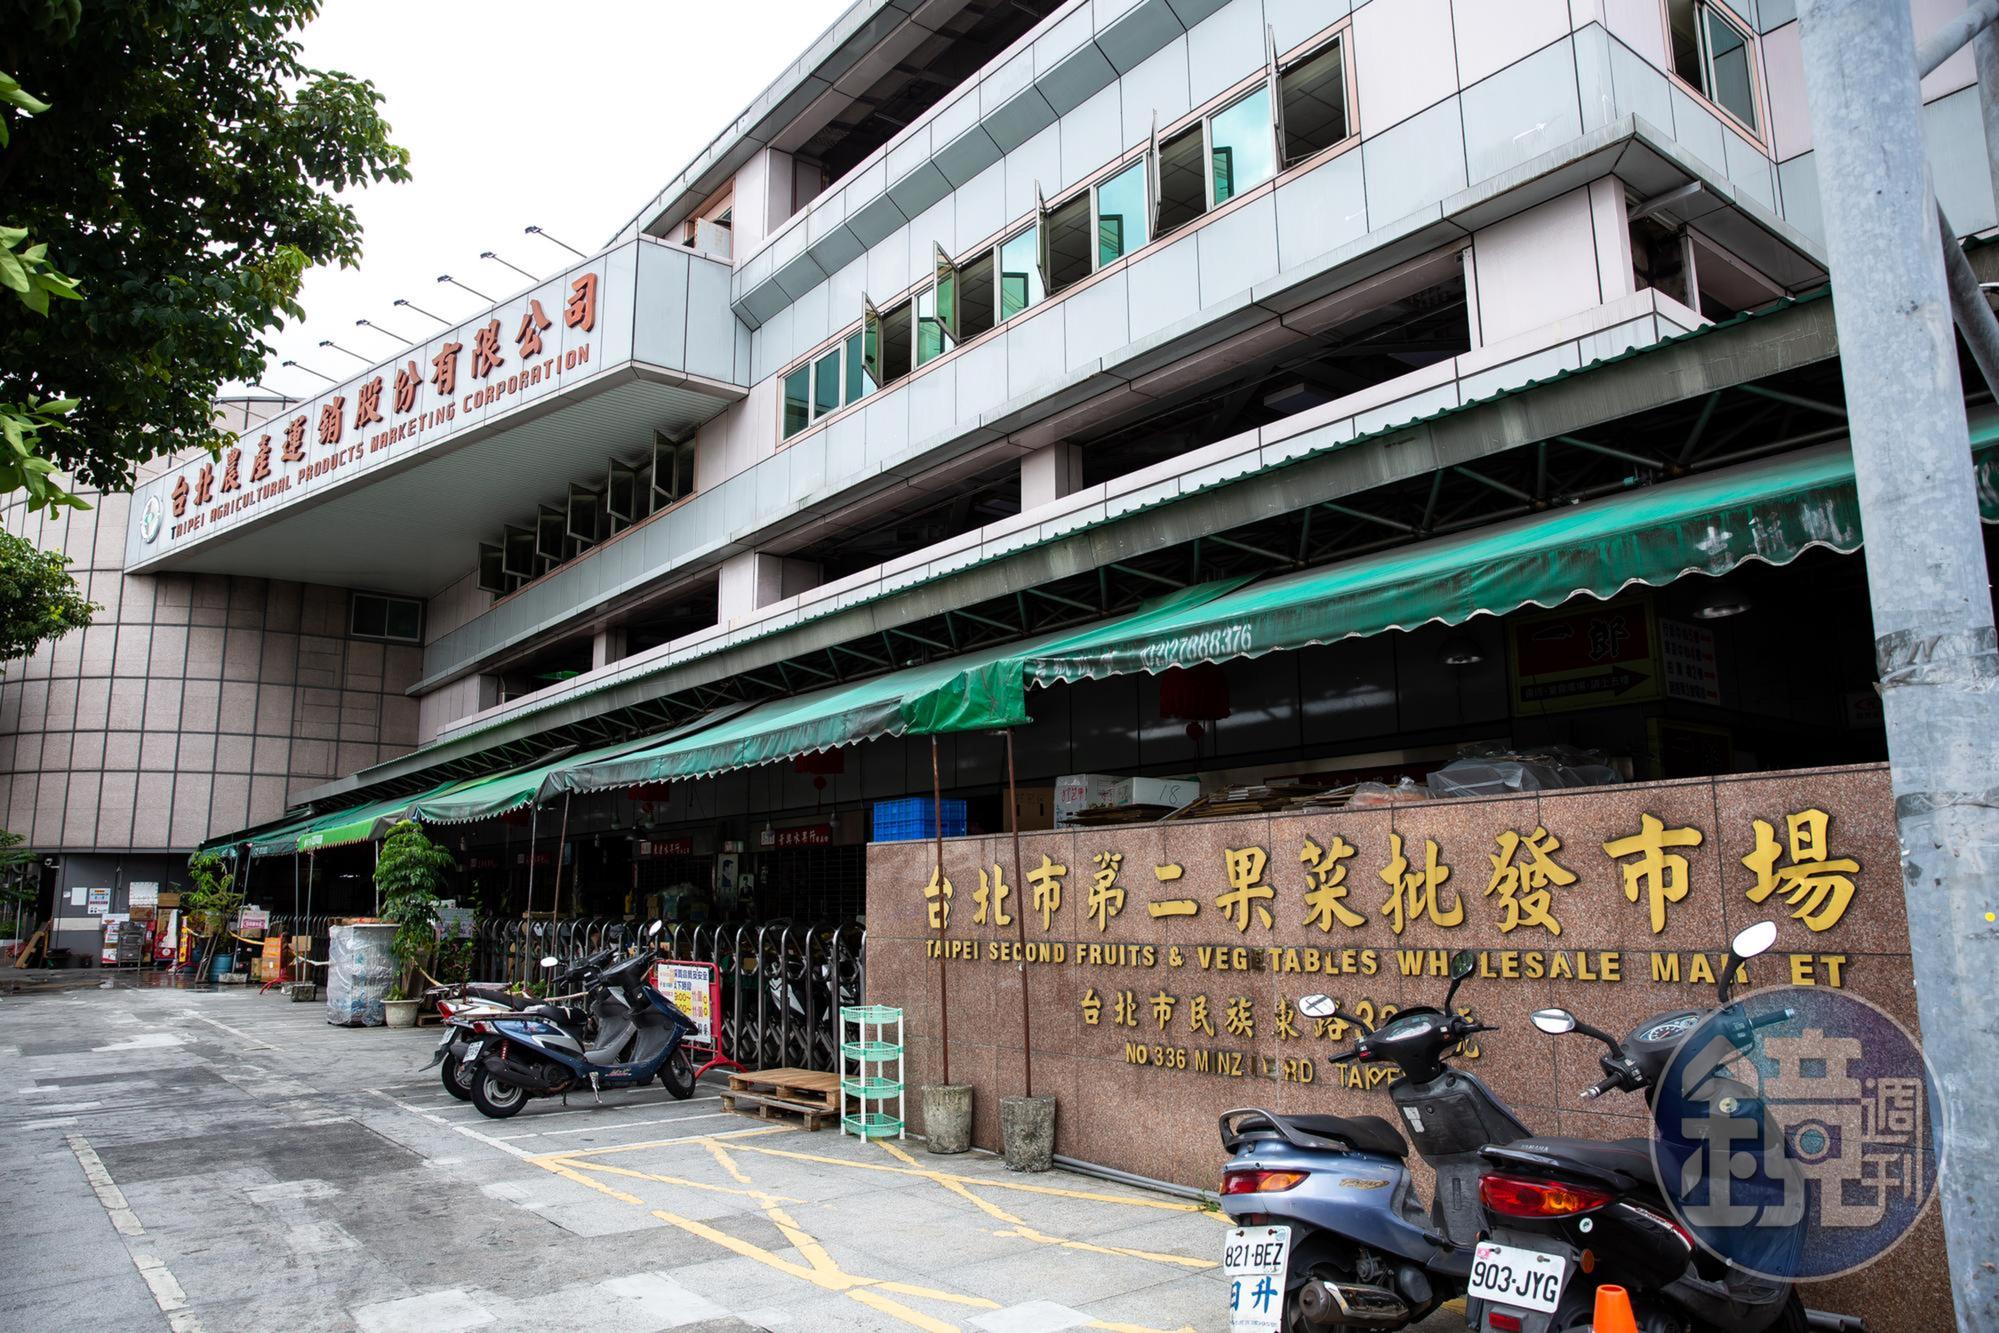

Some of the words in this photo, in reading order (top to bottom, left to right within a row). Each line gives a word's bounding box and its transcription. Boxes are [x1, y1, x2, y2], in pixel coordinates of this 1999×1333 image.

[170, 272, 598, 518] 台北農產運銷股份有限公司
[171, 513, 205, 541] TAIPEI
[210, 475, 292, 523] AGRICULTURAL
[297, 442, 364, 485] PRODUCTS
[370, 402, 456, 453] MARKETING
[463, 343, 590, 414] CORPORATION
[1159, 783, 1182, 805] 18
[923, 808, 1860, 936] 台北市第二果菜批發市場
[926, 939, 979, 960] TAIPEI
[989, 941, 1065, 963] SECOND
[1076, 943, 1155, 967] FRUITS
[1168, 945, 1184, 967] &
[1199, 946, 1378, 975] VEGTABLES
[1397, 950, 1621, 981] WHLESALE
